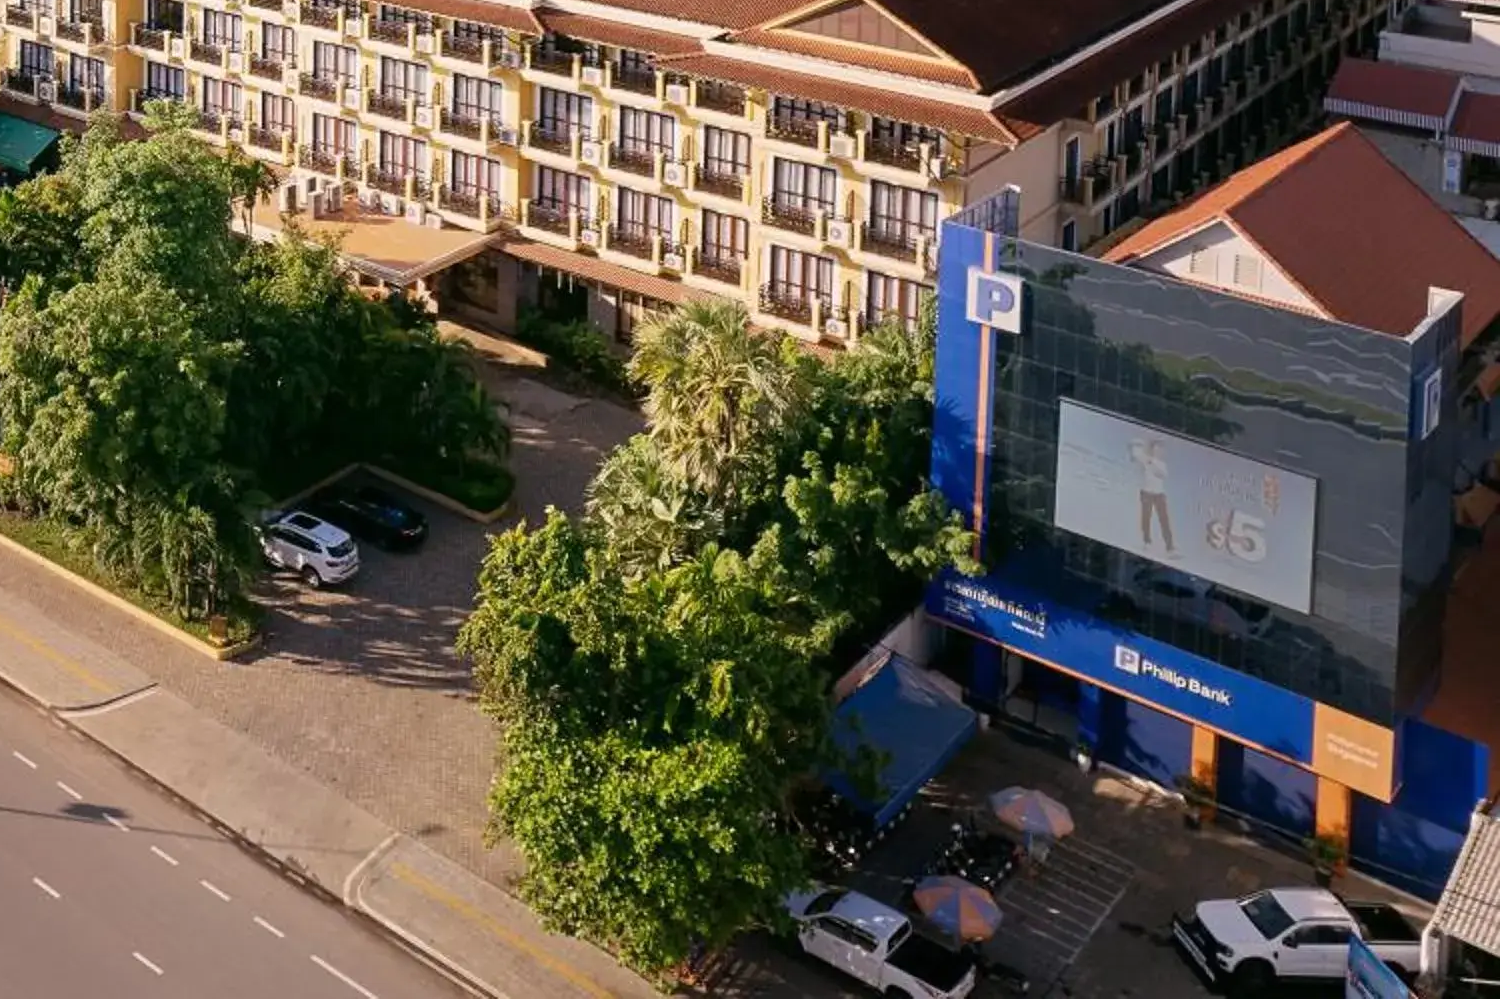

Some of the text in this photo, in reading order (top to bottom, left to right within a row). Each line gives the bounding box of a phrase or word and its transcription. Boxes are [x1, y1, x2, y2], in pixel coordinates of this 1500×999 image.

[975, 276, 1015, 322] P
[1206, 510, 1267, 562] $5
[1141, 658, 1187, 688] Phillip
[1187, 678, 1231, 706] Bank
